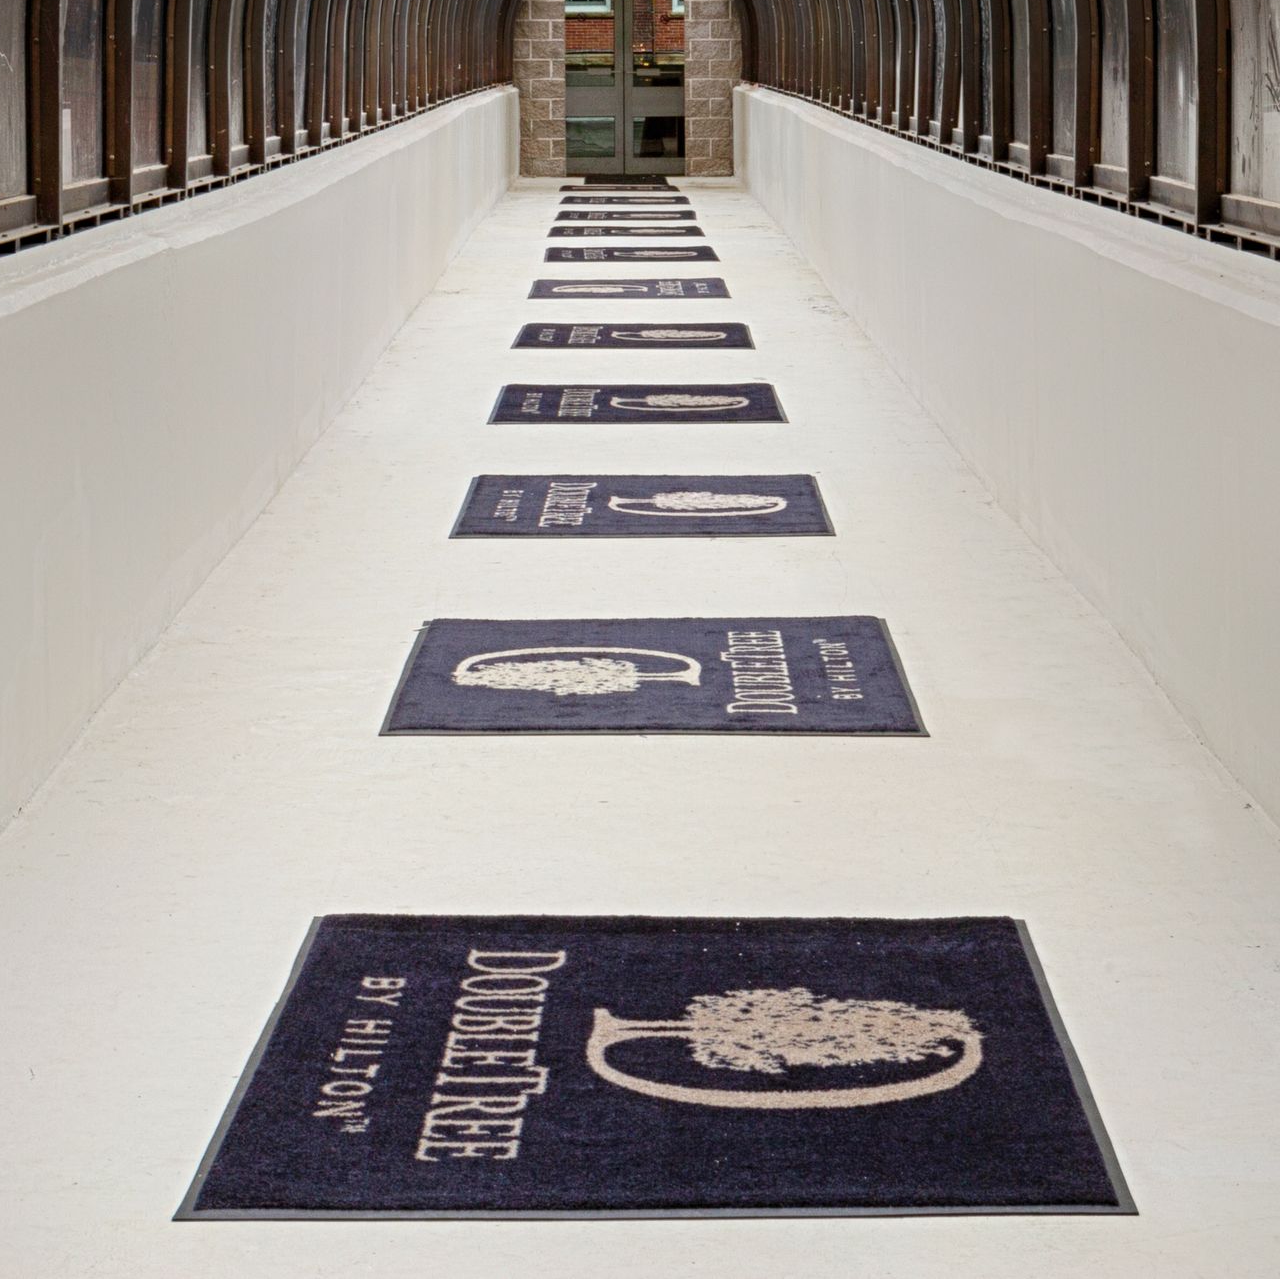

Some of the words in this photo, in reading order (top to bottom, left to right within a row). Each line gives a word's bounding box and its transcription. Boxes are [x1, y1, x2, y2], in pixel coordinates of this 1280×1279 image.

[720, 630, 798, 714] DOUBLETREE
[831, 686, 864, 699] BY
[356, 977, 407, 1007] BY
[415, 949, 566, 1161] DOUBLETREE
